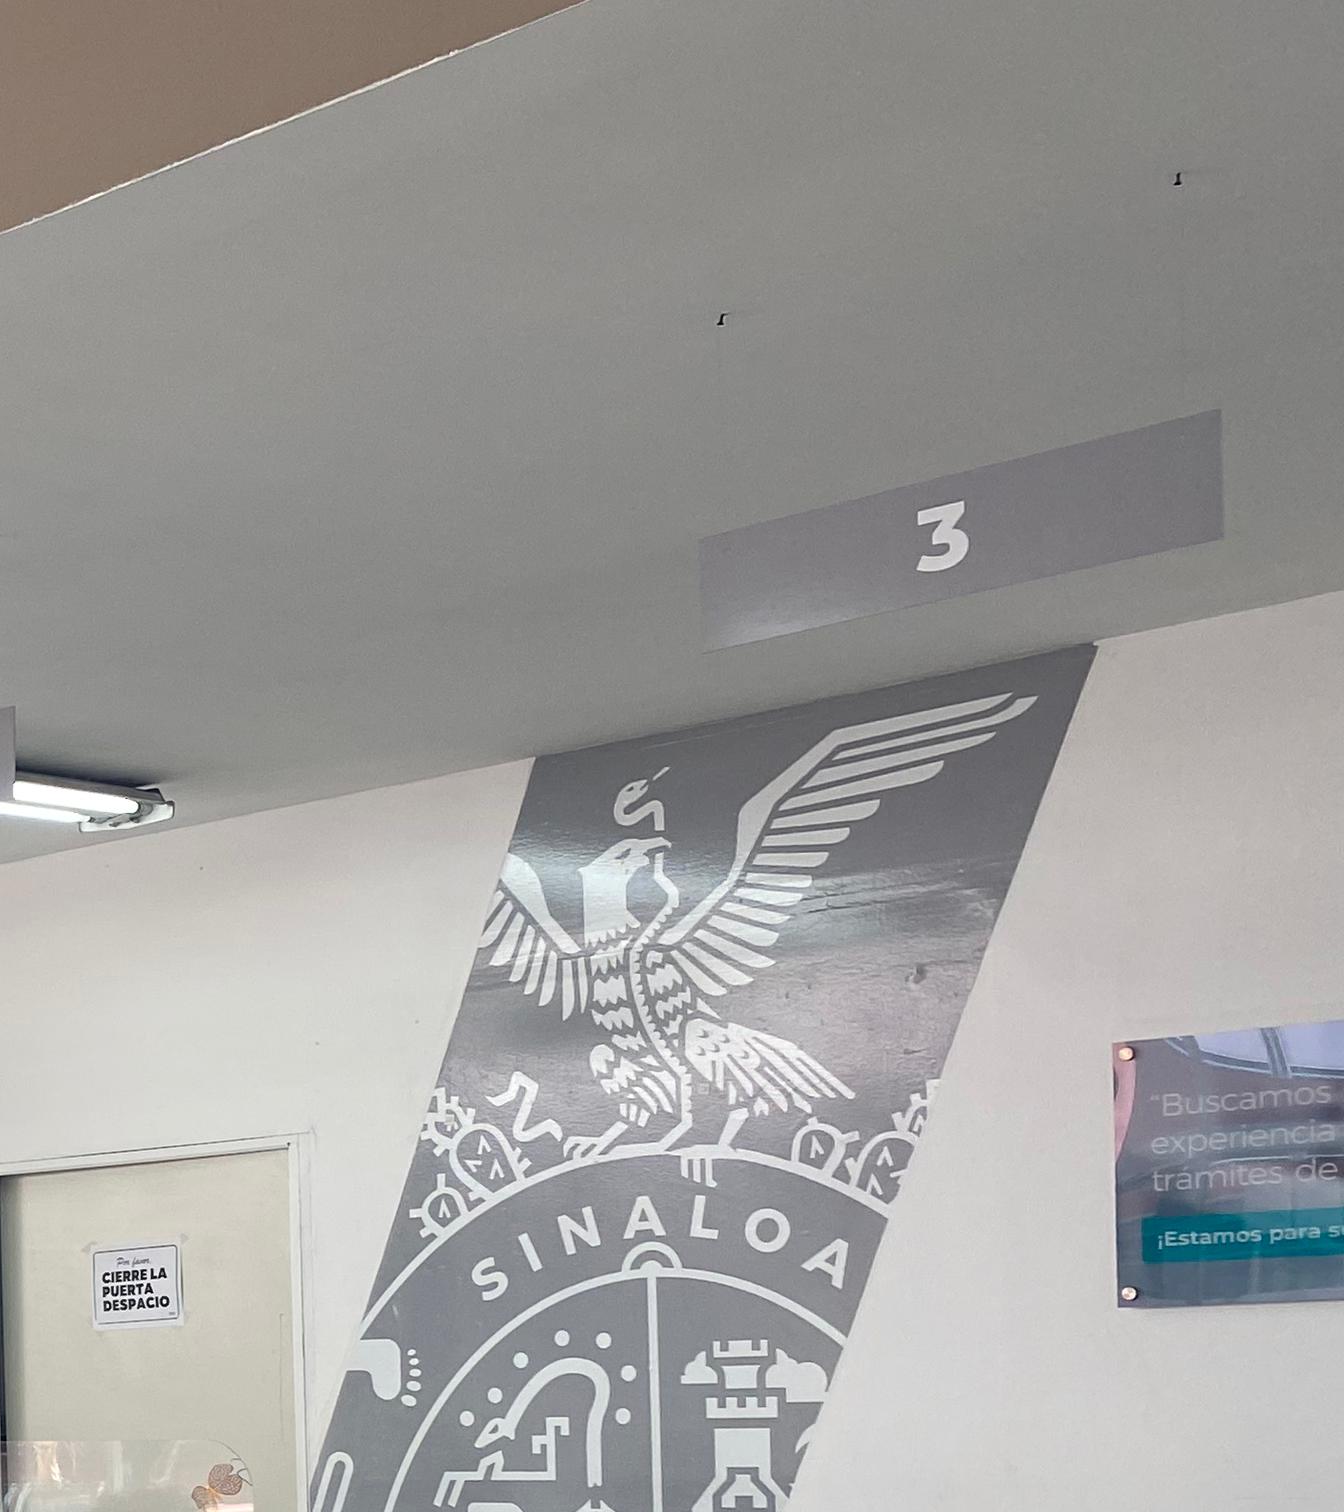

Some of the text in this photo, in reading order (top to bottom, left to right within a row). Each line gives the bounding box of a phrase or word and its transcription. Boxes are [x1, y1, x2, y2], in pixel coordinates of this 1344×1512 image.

[915, 500, 970, 573] 3
[1151, 1119, 1336, 1158] experiencia
[1152, 1157, 1339, 1192] trámites de
[470, 1194, 850, 1302] SINALOA
[1158, 1229, 1263, 1250] ¡Estamos
[1269, 1226, 1321, 1244] para
[102, 1267, 168, 1284] CIERRE LA
[102, 1283, 154, 1298] PUERTA
[103, 1296, 170, 1312] DESPACIO
